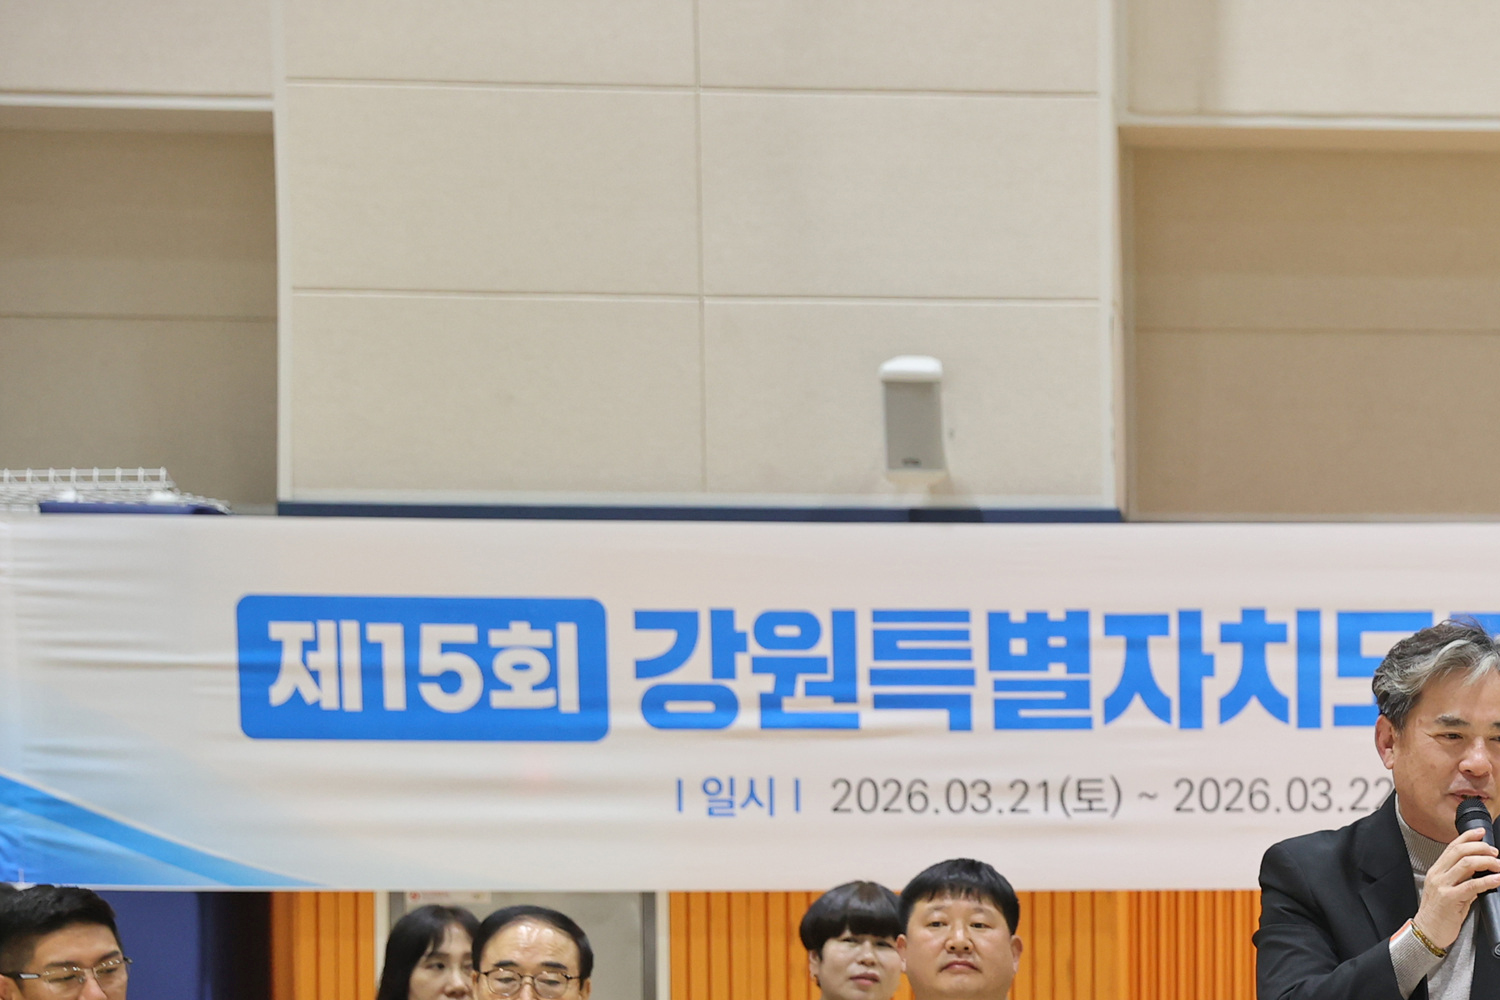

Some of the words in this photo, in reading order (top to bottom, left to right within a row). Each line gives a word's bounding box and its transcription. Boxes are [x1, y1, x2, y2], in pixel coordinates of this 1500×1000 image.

[268, 618, 580, 714] 제15회
[702, 776, 775, 817] 일시
[831, 775, 1122, 818] 2026.03.21(토)
